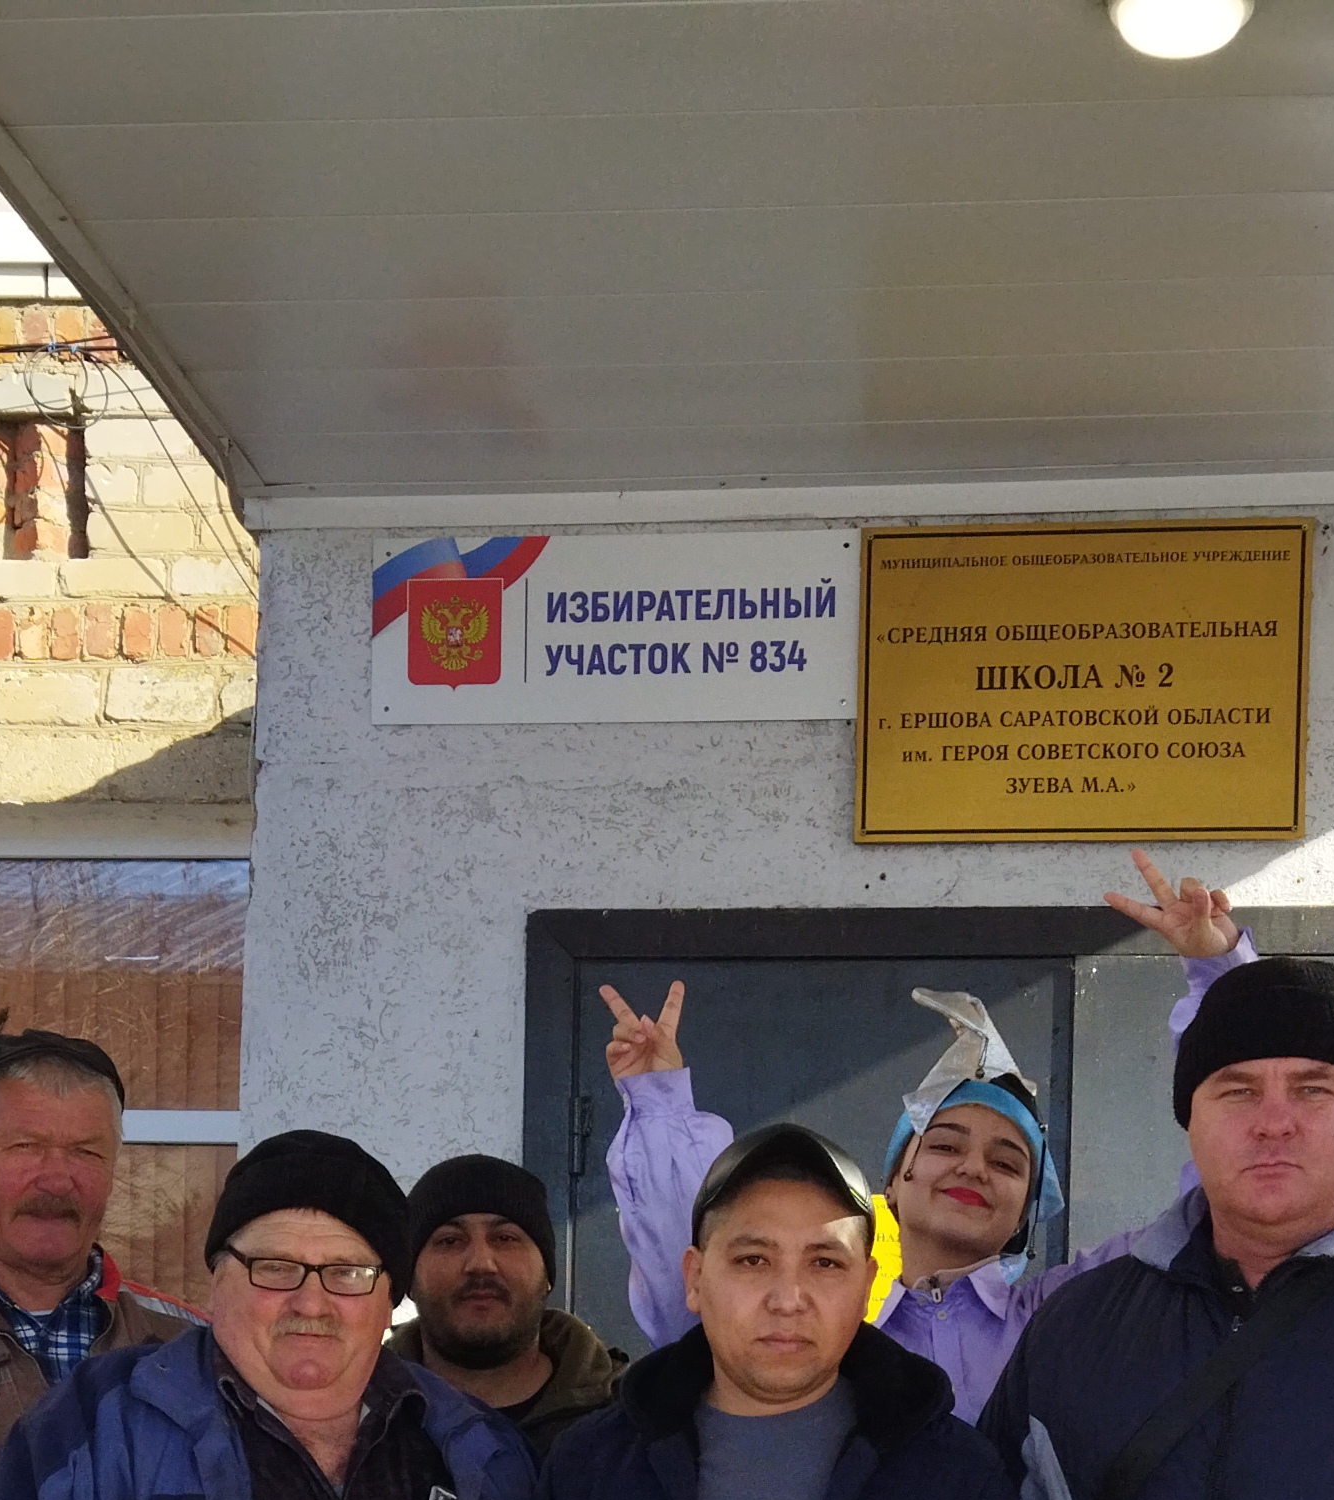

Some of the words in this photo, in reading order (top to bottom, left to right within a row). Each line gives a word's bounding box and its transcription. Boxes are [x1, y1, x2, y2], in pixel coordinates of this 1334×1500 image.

[880, 553, 1008, 571] МУНИЦИПАЛЬНОЕ
[1011, 550, 1189, 567] ОБЩЕОБРАЗОВАТЕЛЬНОЕ
[1192, 548, 1292, 564] УЧРЕЖДЕНИЕ
[546, 577, 836, 623] ИЗБИРАТЕЛЬНЫЙ
[876, 624, 988, 646] «СРЕДНЯЯ
[995, 619, 1279, 643] ОБЩЕОБРАЗОВАТЕЛЬНАЯ
[544, 642, 692, 677] УЧАСТОК
[701, 641, 740, 674] №
[749, 639, 807, 673] 834
[975, 663, 1104, 691] ШКОЛА
[1114, 663, 1146, 689] №
[1157, 662, 1175, 689] 2
[877, 717, 892, 731] г.
[900, 710, 994, 730] ЕРШОВА
[999, 704, 1160, 728] САРАТОВСКОЙ
[1167, 706, 1272, 726] ОБЛАСТИ
[901, 749, 933, 763] им.
[941, 744, 1010, 762] ГЕРОЯ
[1016, 741, 1160, 761] СОВЕТСКОГО
[1166, 741, 1246, 759] СОЮЗА
[1005, 776, 1074, 795] ЗУЕВА
